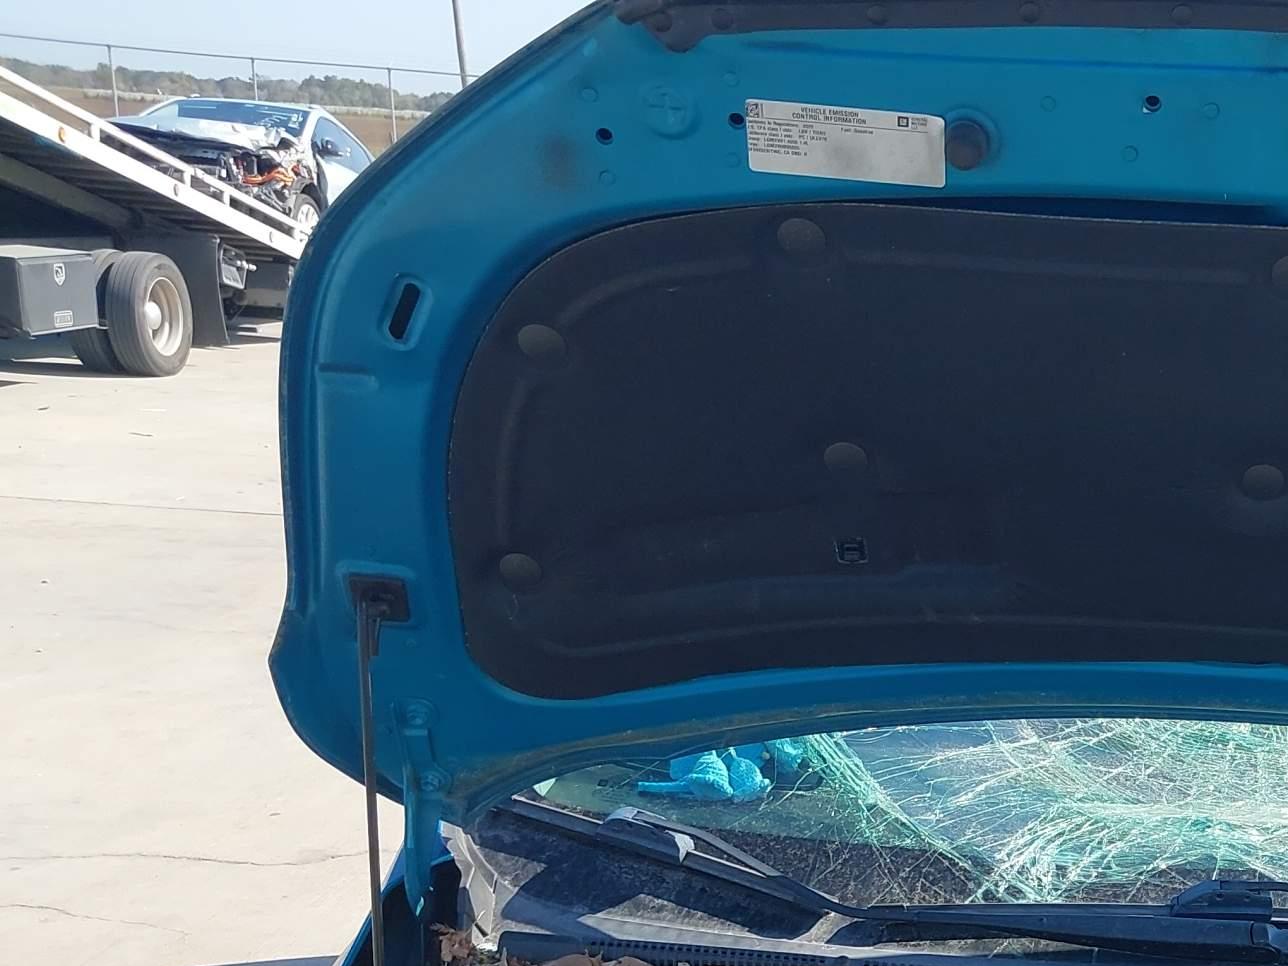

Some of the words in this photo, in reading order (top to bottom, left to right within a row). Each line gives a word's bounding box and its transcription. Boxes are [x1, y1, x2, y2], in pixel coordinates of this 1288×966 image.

[792, 112, 820, 121] CONTROL
[823, 115, 867, 125] INFORMATION
[800, 107, 827, 115] VEHICLE
[828, 109, 859, 118] EMISSION
